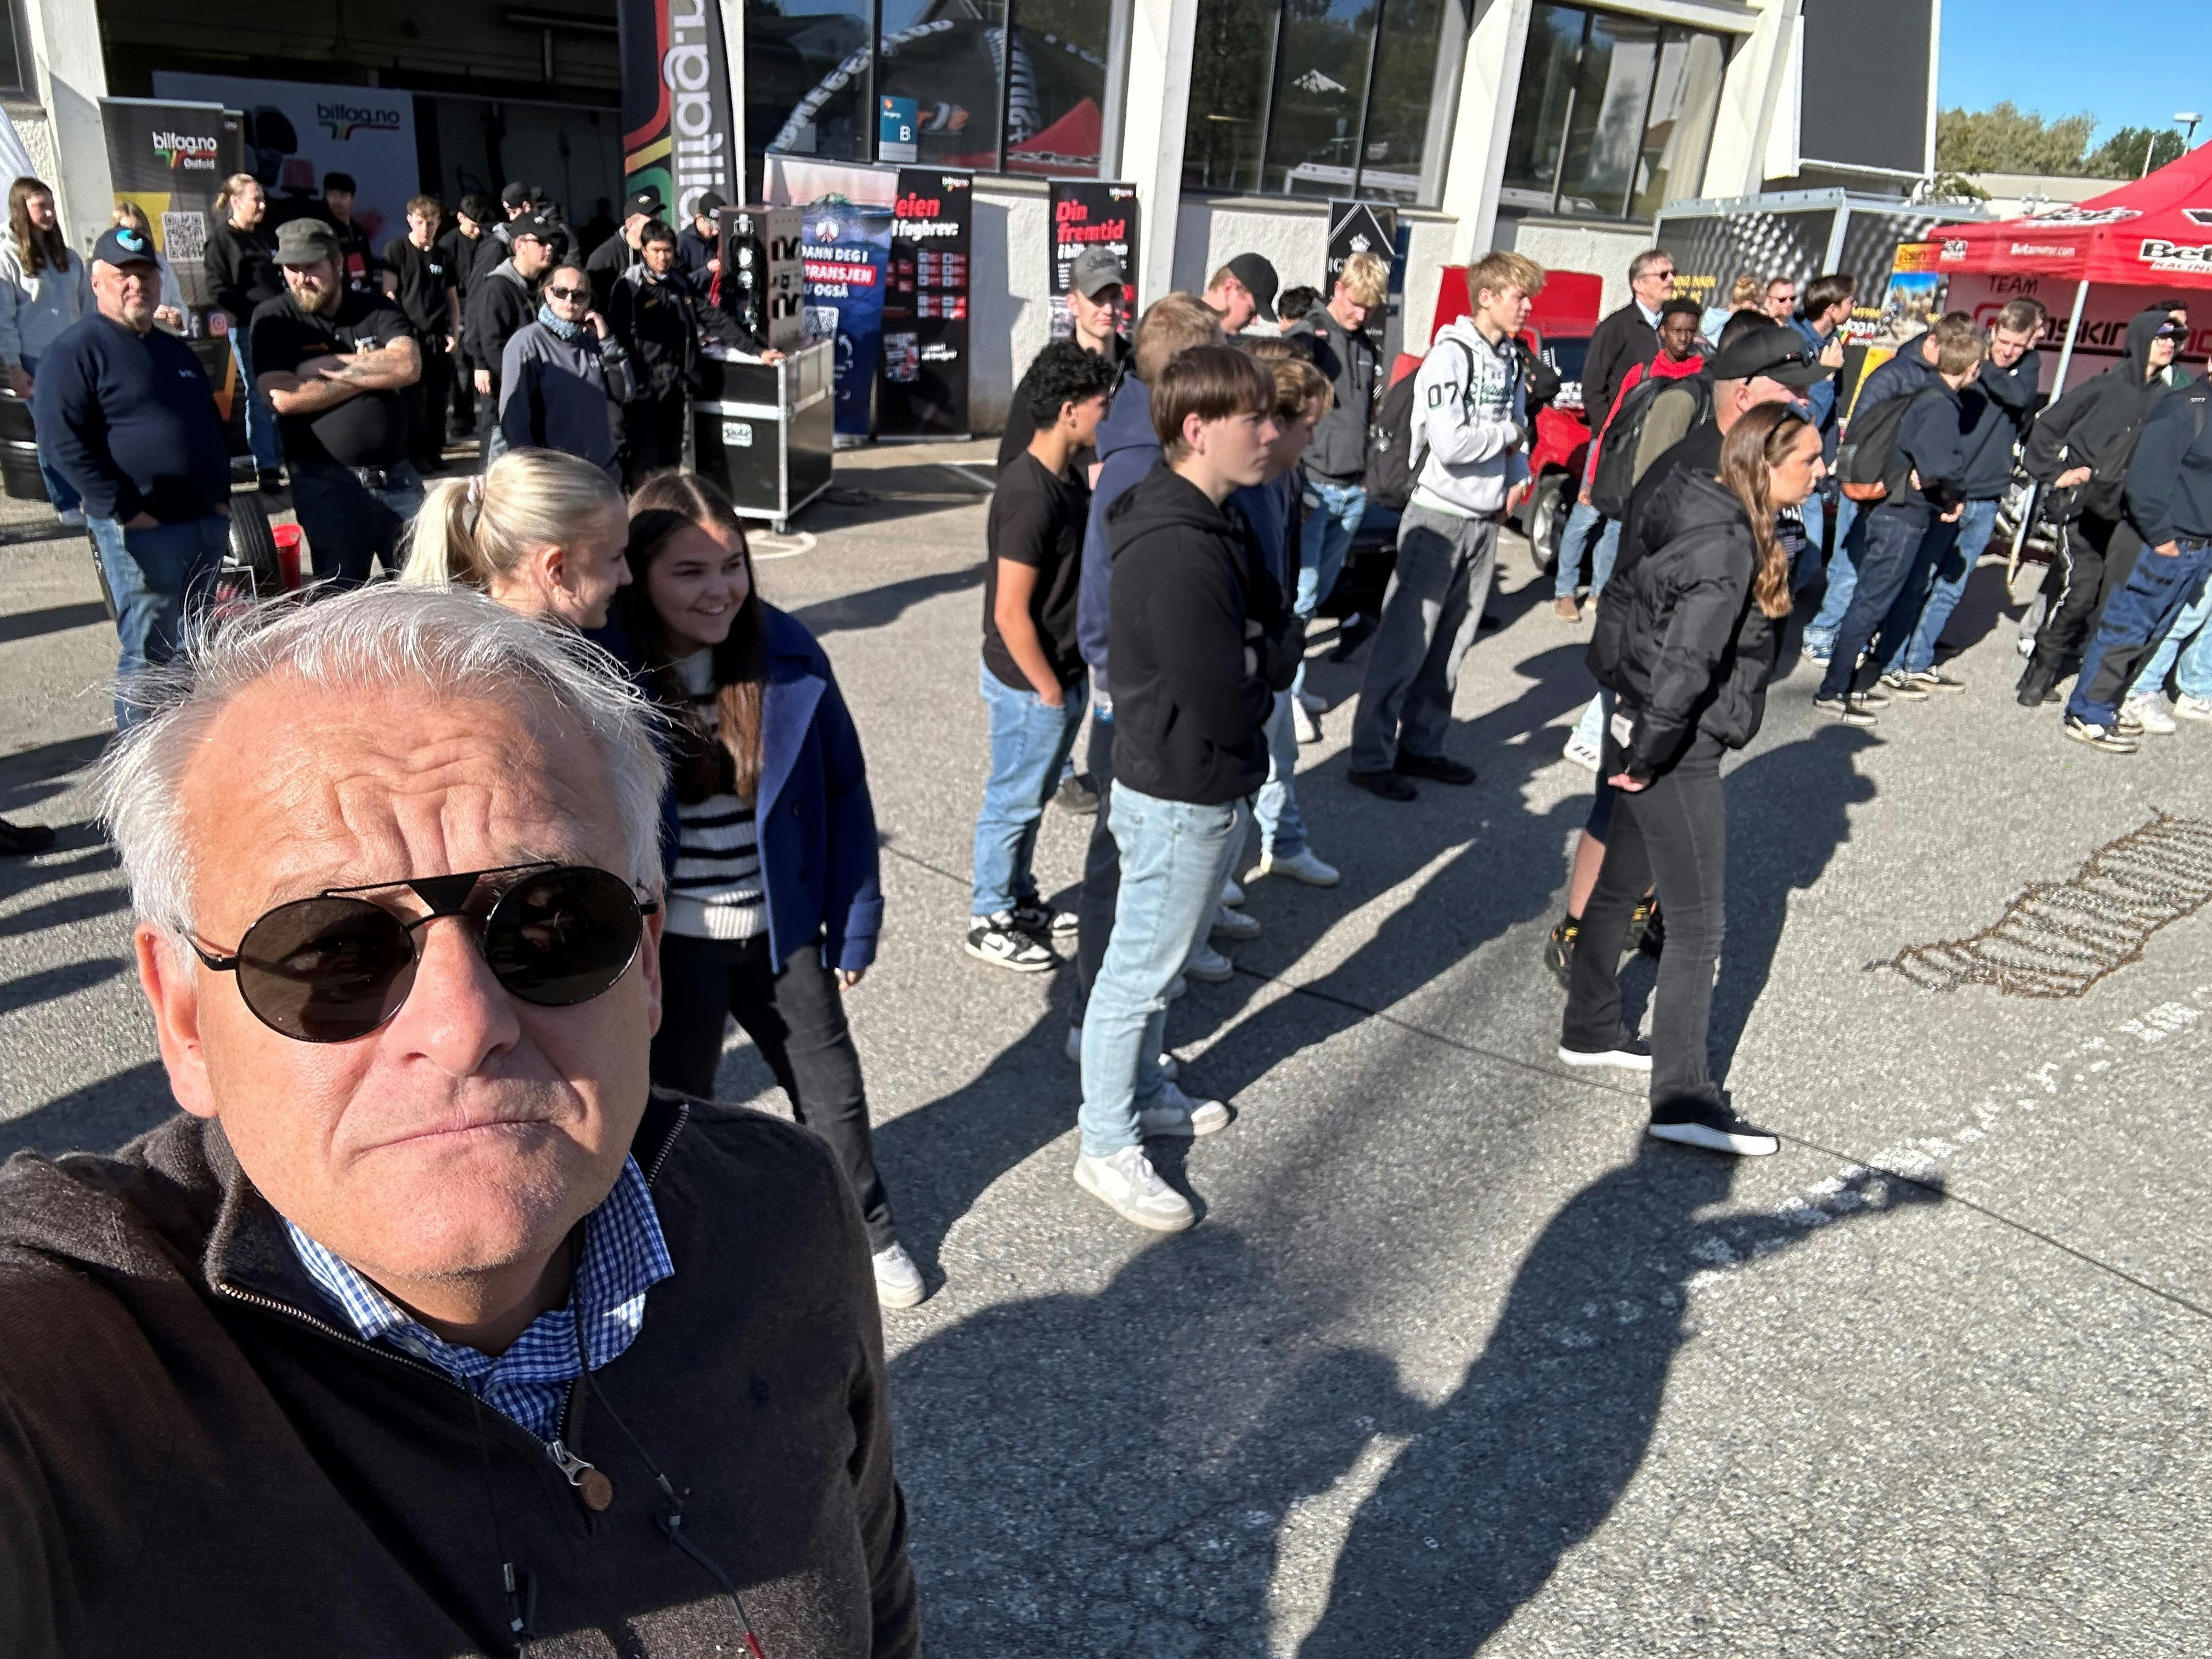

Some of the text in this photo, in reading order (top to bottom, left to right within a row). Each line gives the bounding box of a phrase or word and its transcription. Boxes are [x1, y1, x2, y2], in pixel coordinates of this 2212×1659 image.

[317, 101, 400, 125] bilfag.no
[152, 131, 217, 155] bilfag.no
[900, 126, 911, 141] B
[894, 191, 941, 217] eien
[1056, 199, 1088, 222] Din
[1057, 218, 1126, 243] fremtid
[835, 248, 861, 262] DEG
[1989, 275, 2038, 295] TEAM
[1428, 381, 1459, 409] 07
